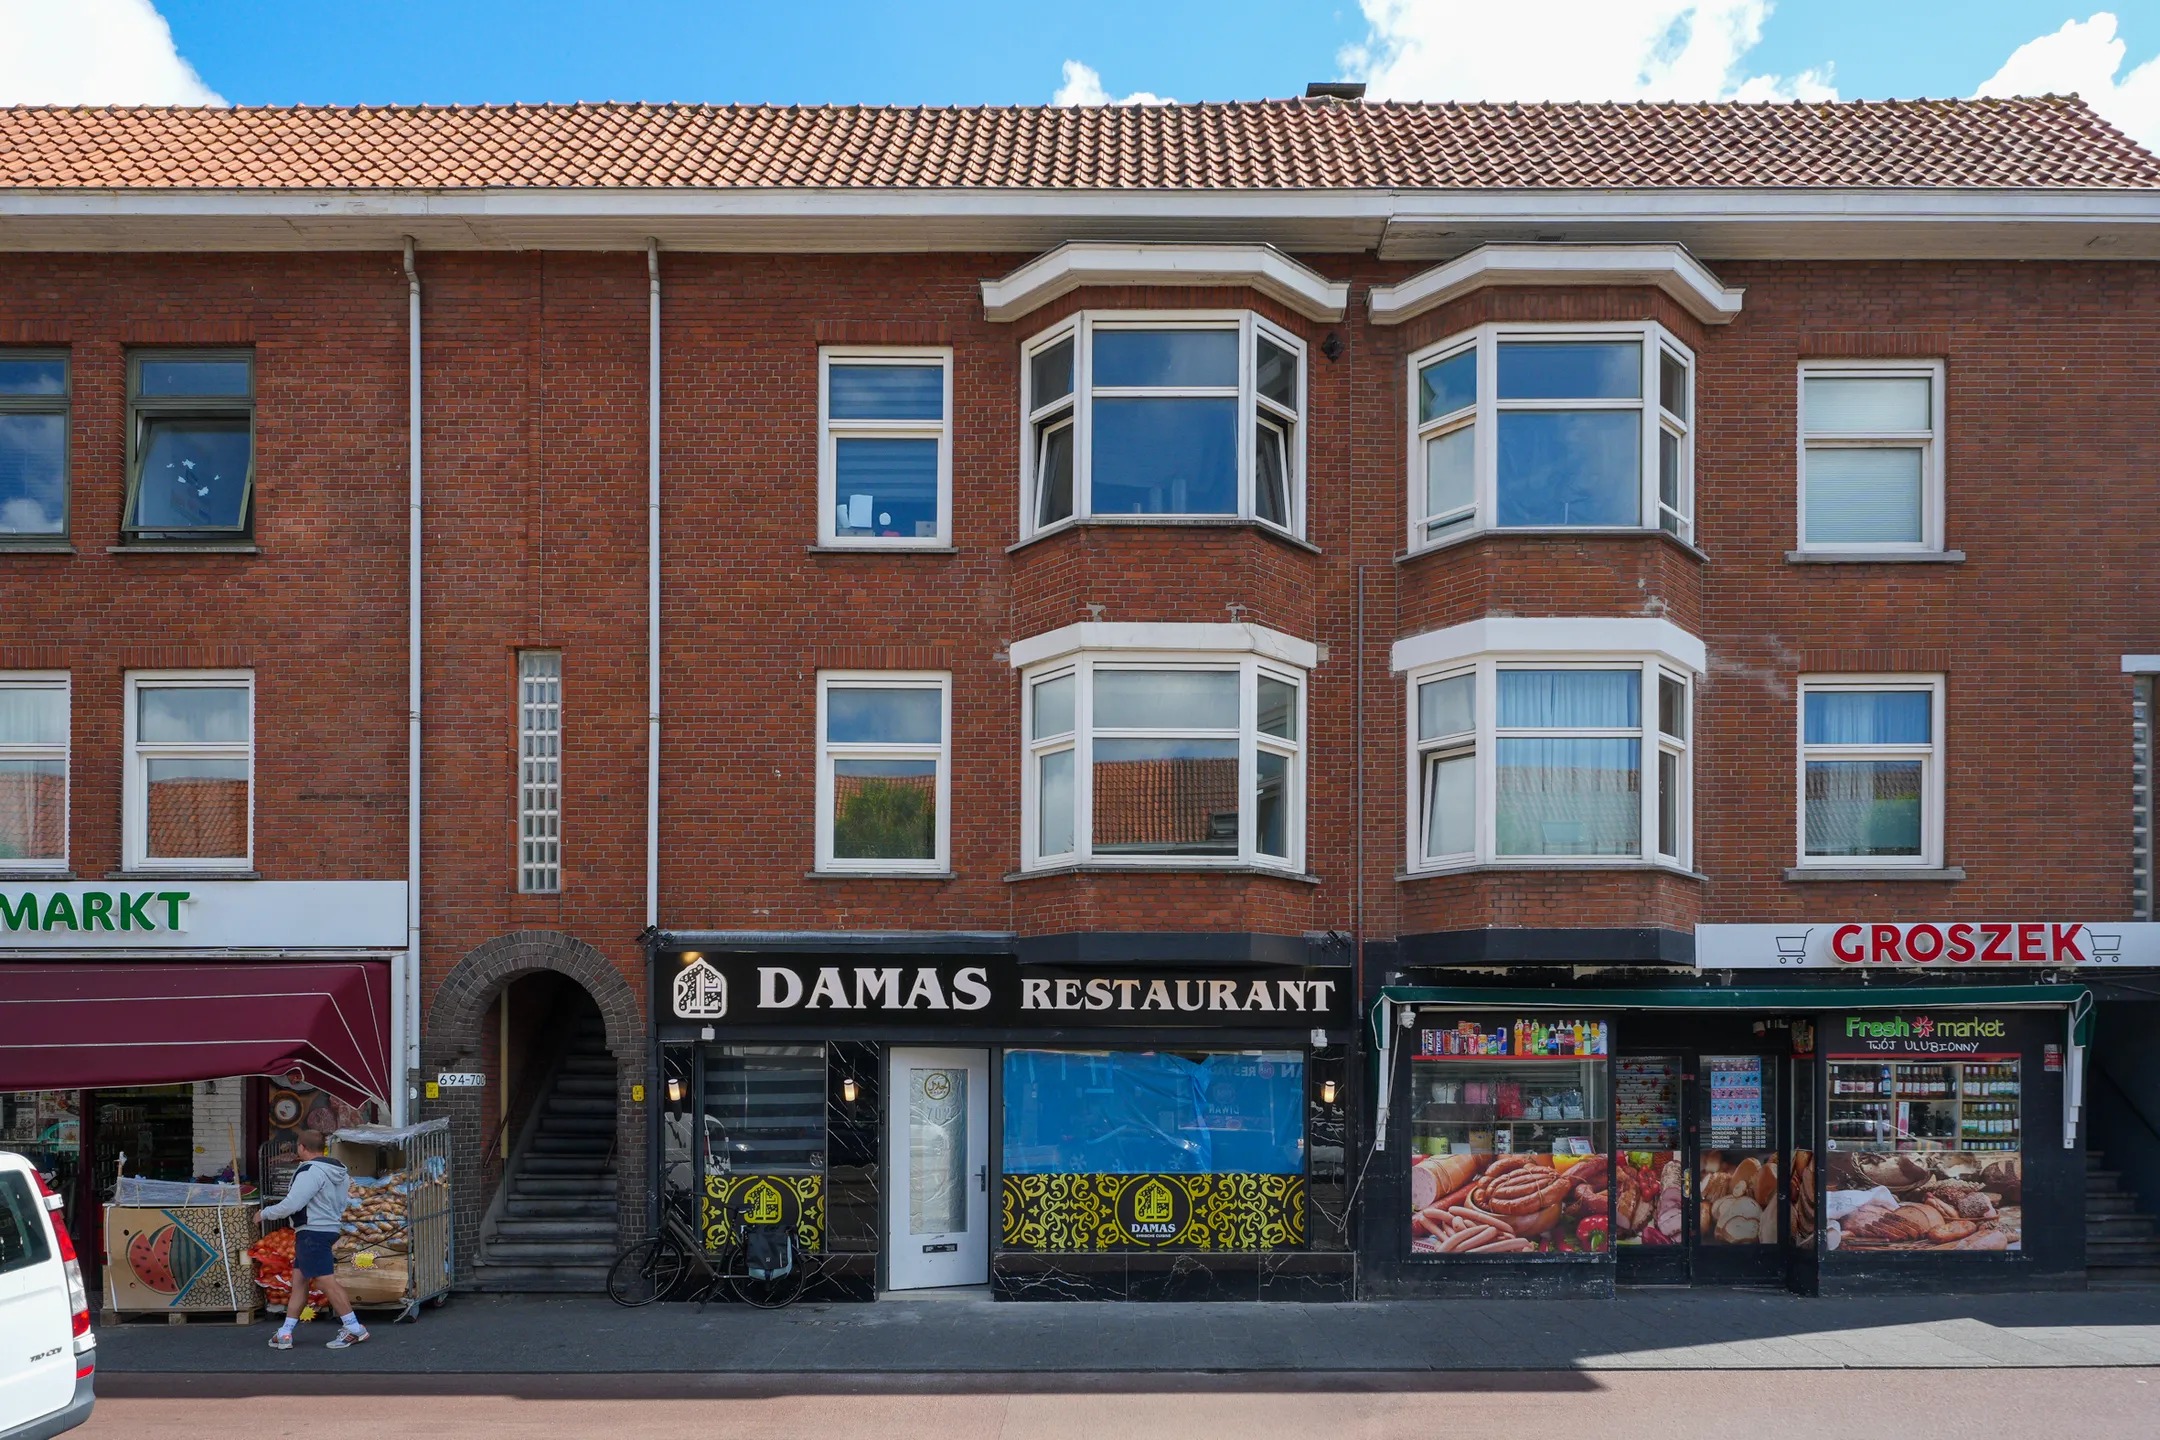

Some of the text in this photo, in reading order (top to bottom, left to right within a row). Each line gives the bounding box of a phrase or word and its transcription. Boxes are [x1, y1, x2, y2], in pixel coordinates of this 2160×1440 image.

[0, 892, 191, 931] MARKT
[1831, 923, 2087, 963] GROSZEK
[756, 966, 992, 1011] DAMAS
[1020, 978, 1336, 1012] RESTAURANT
[1846, 1016, 2006, 1038] Fresh market
[1904, 1040, 1980, 1053] ULUBIONNY
[1131, 1224, 1176, 1233] DAMAS
